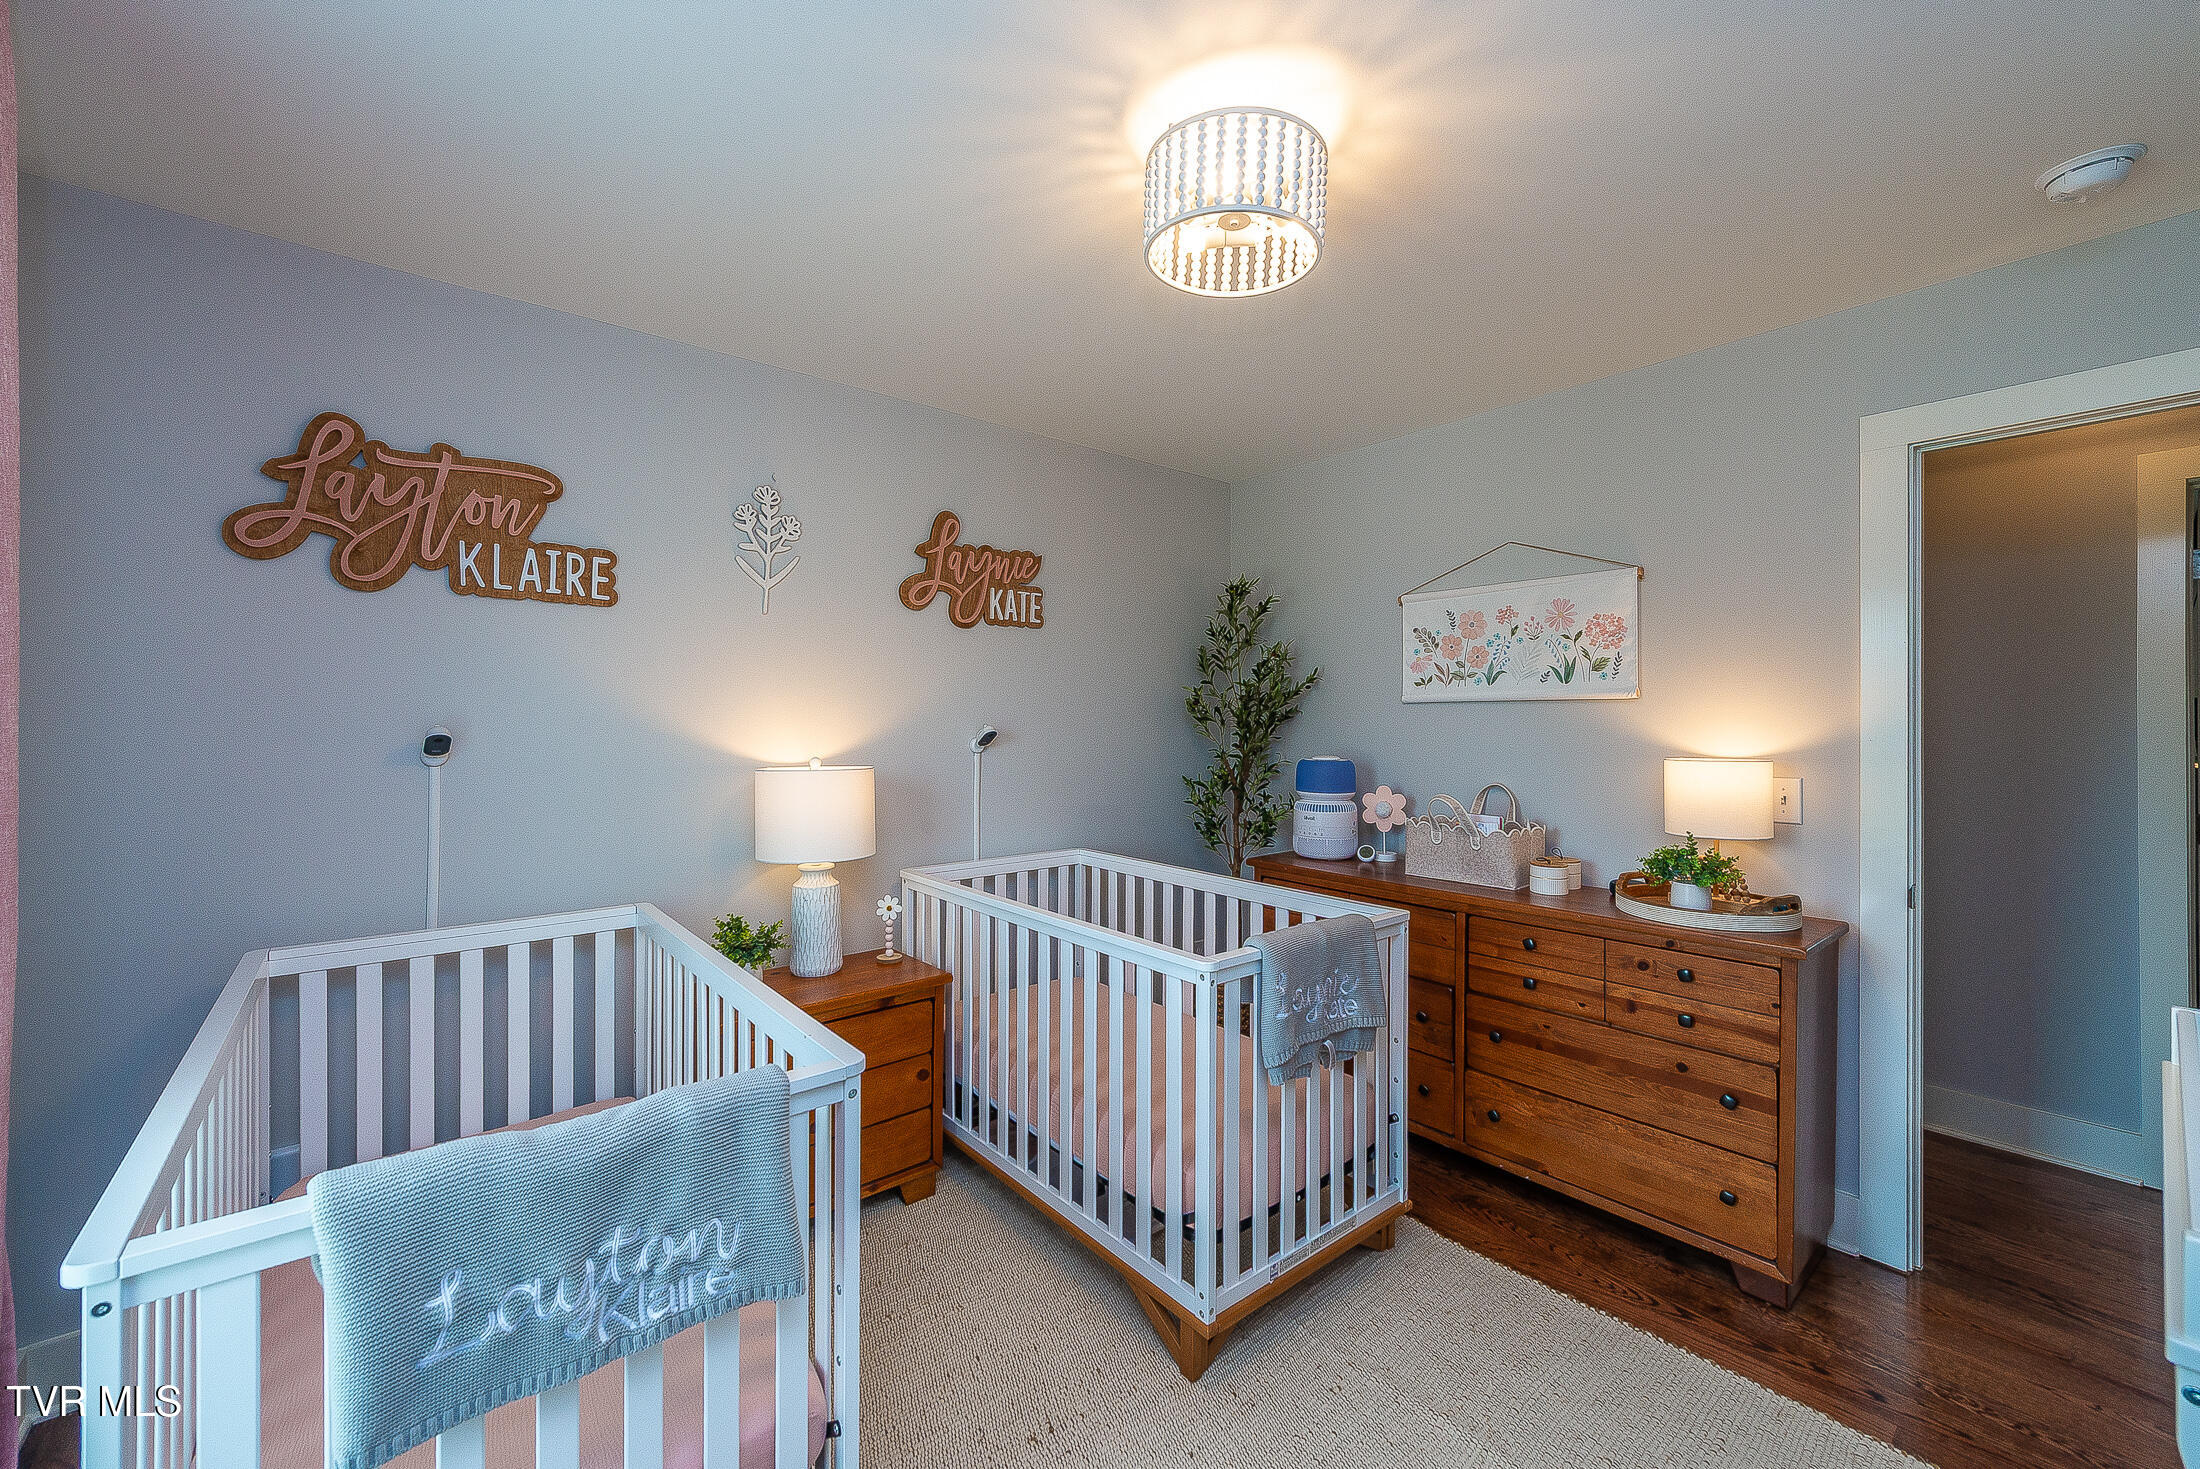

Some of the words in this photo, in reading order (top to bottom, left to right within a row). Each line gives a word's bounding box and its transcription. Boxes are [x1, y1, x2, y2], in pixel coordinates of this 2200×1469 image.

[234, 419, 556, 582] Layton
[459, 540, 612, 601] KLAIRE
[989, 587, 1042, 624] KATE
[415, 1217, 741, 1370] Layton
[599, 1266, 736, 1342] Klaire
